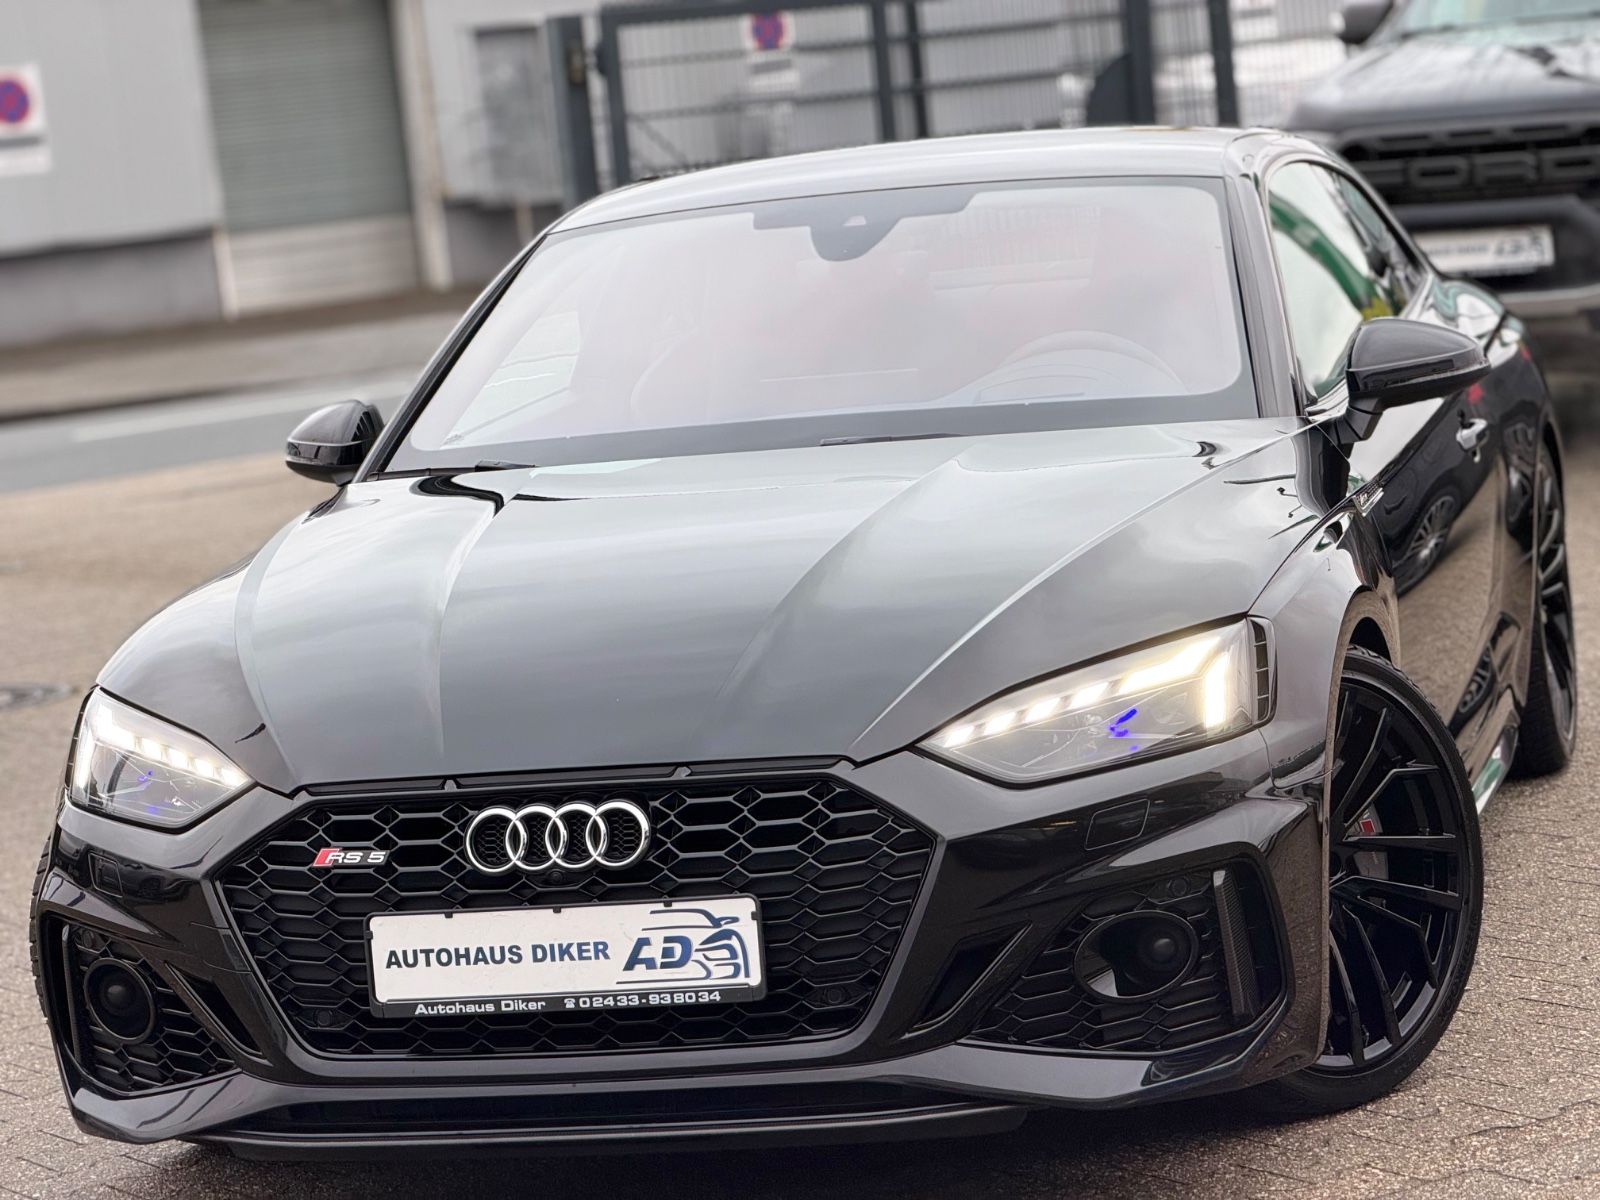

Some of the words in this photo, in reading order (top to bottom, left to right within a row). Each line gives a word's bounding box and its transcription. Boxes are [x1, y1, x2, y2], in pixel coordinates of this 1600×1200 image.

[325, 851, 363, 864] RS
[367, 851, 386, 863] 5
[385, 944, 523, 969] AUTOHAUS
[531, 940, 611, 963] DIKER
[622, 935, 693, 972] AD
[414, 1002, 496, 1015] Autohaus
[501, 999, 547, 1011] Diker
[578, 990, 721, 1009] 02433-938034
